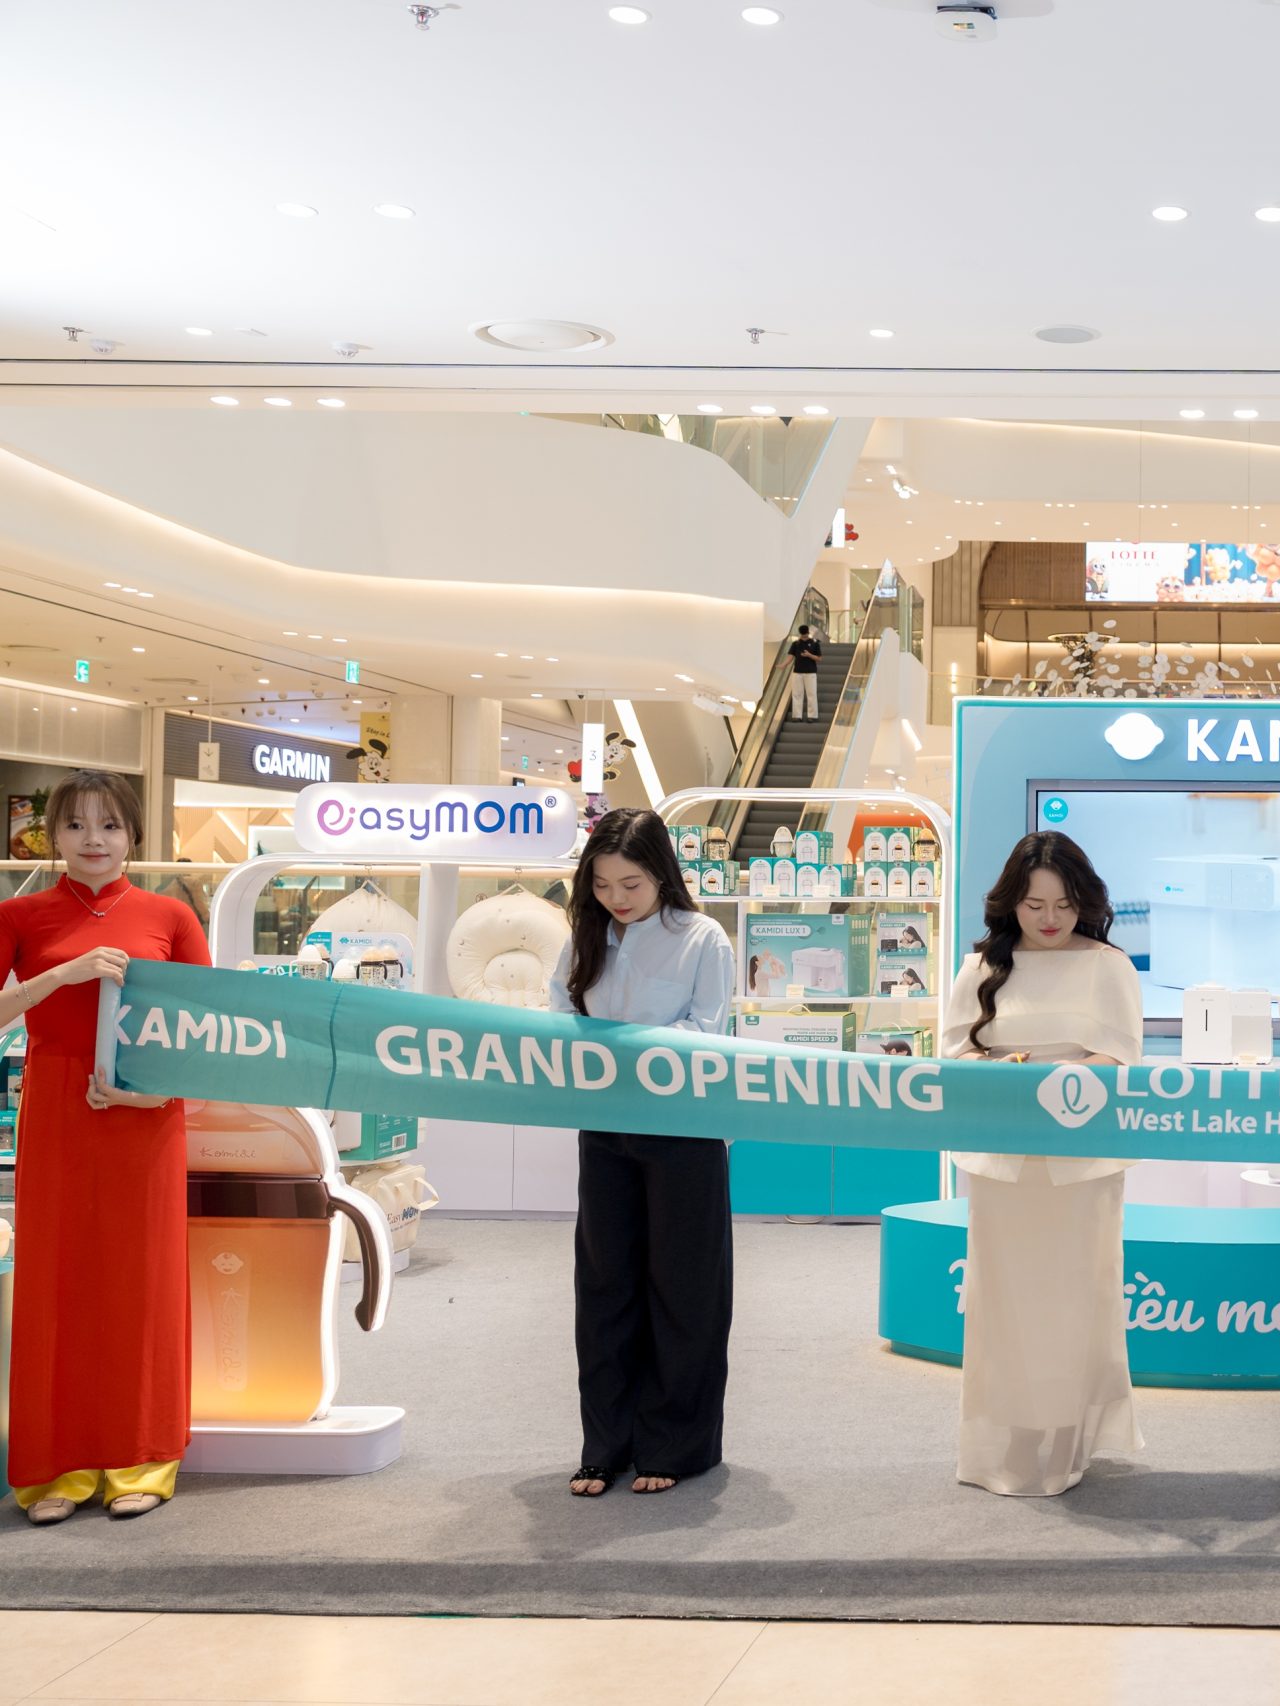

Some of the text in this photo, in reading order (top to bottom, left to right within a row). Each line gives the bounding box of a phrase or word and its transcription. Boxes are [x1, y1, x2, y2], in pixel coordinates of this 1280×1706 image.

[254, 744, 331, 782] GARMIN
[589, 750, 597, 761] 3
[375, 1025, 618, 1090] GRAND
[636, 1046, 944, 1112] OPENING
[1116, 1107, 1185, 1132] West
[1192, 1108, 1258, 1135] Lake
